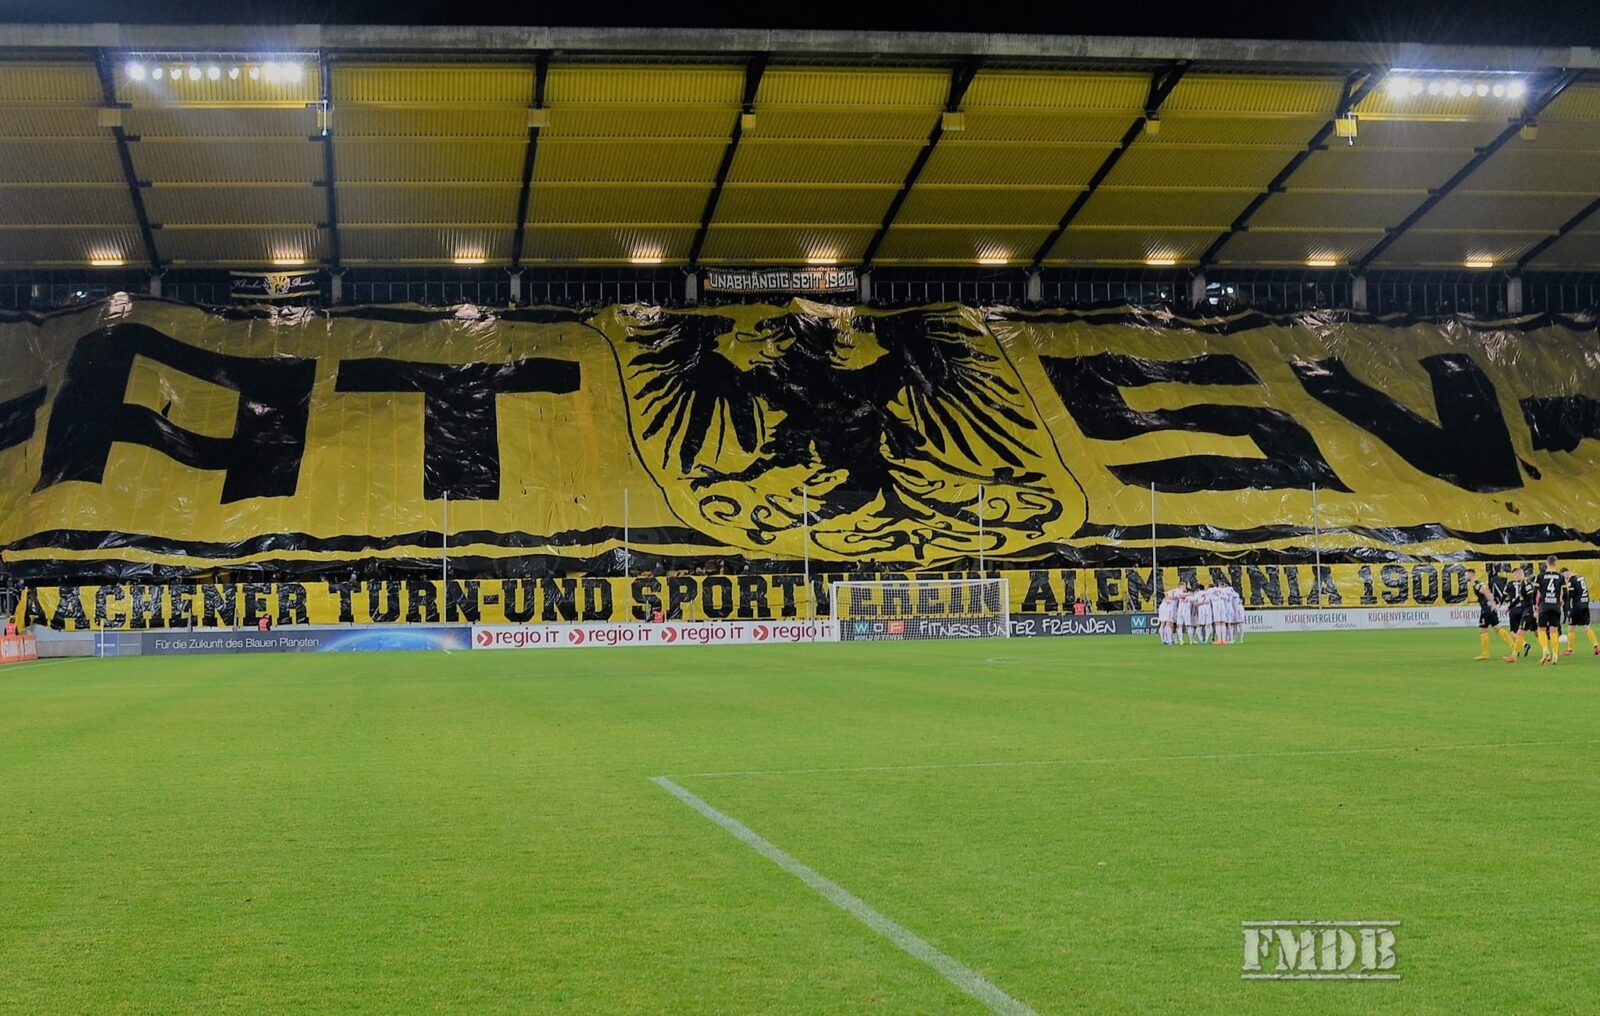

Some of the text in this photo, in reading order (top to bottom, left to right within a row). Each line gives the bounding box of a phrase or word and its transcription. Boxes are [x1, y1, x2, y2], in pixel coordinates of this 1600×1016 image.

[709, 272, 789, 289] UNABHÄNGIG
[792, 273, 822, 289] SEIT
[328, 577, 613, 623] TURN-UND
[1358, 564, 1468, 604] 1900
[920, 621, 981, 637] FITNESS
[1042, 619, 1116, 634] FREUNDEN
[1284, 612, 1347, 624] KÜCHENVERGLEICH
[155, 639, 171, 649] Für
[173, 639, 187, 649] die
[188, 638, 223, 649] Zukunft
[225, 638, 243, 648] des
[245, 637, 277, 648] Blauen
[496, 627, 541, 648] regio
[589, 626, 633, 646] regio
[681, 624, 726, 644] regio
[773, 623, 817, 643] regio
